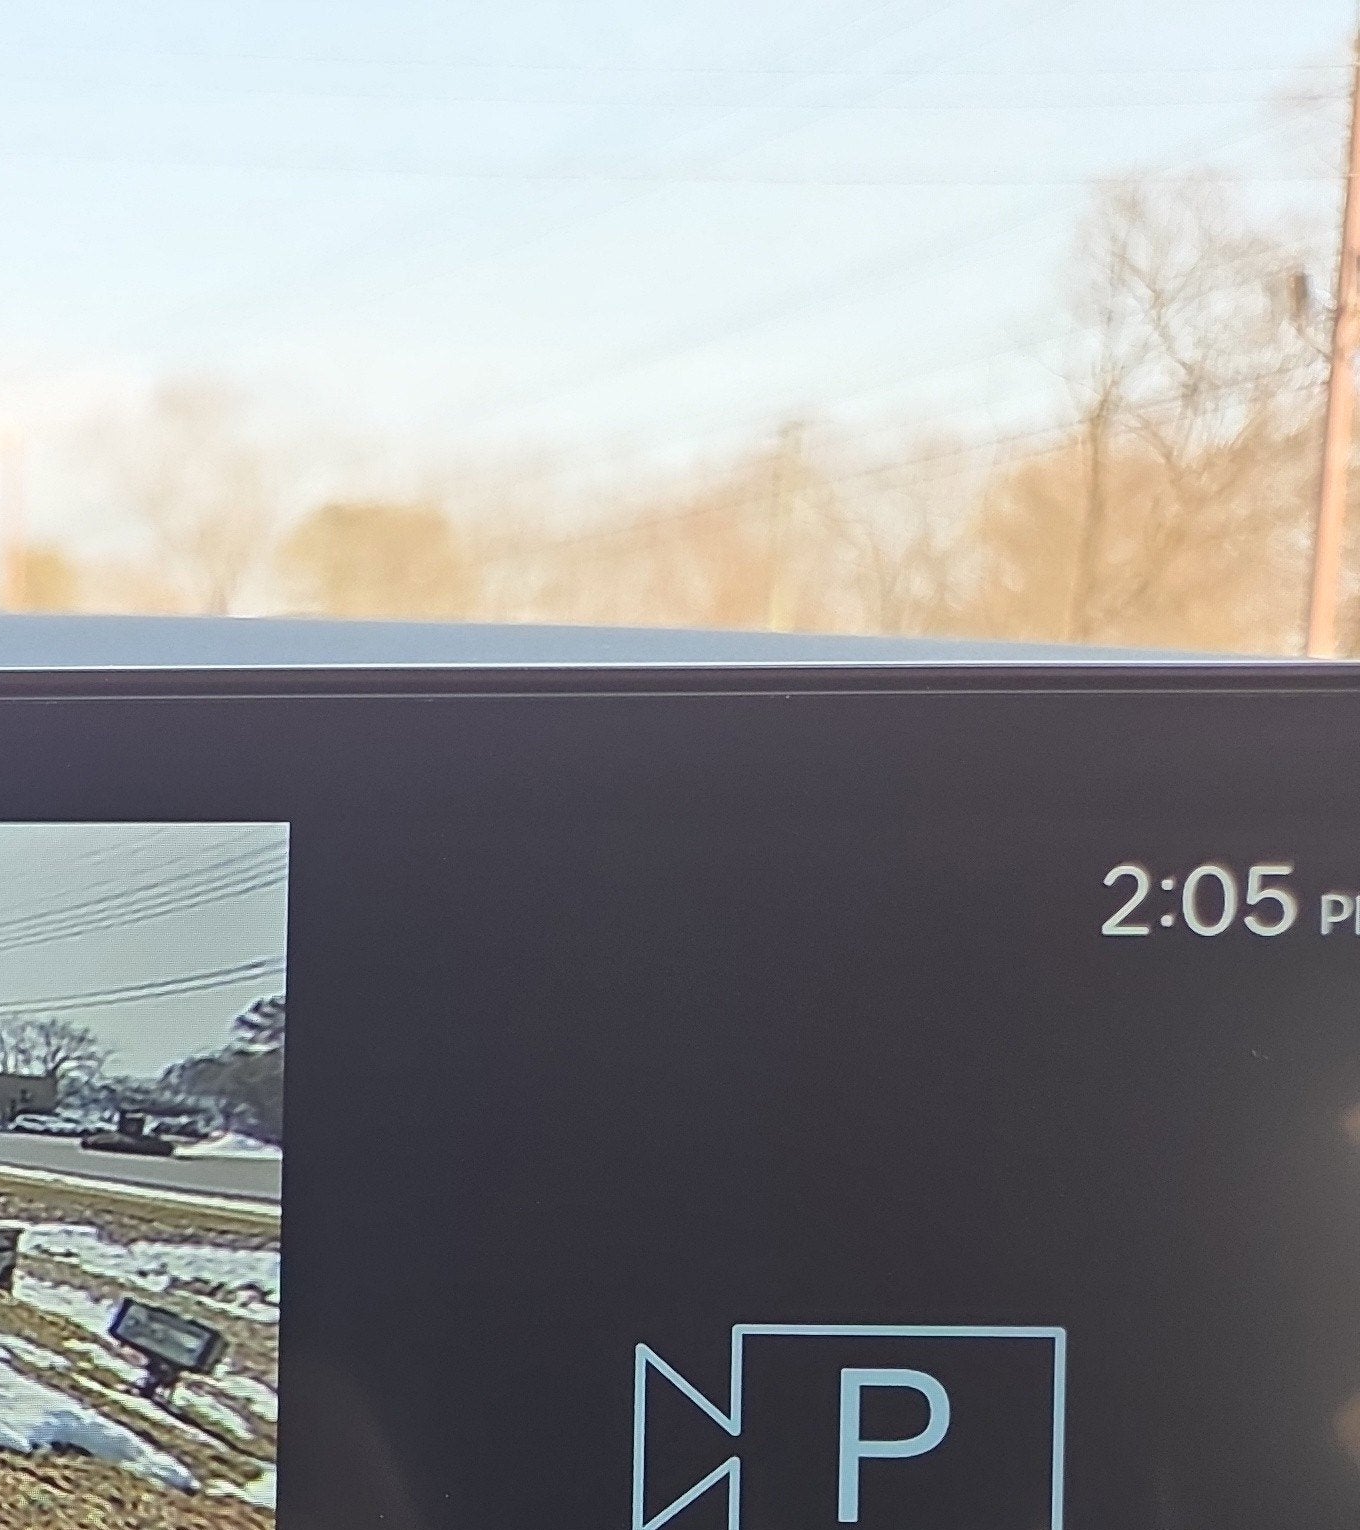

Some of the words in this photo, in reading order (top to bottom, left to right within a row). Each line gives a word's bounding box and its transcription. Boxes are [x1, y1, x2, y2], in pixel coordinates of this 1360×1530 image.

[1100, 864, 1298, 937] 2:05
[1320, 893, 1360, 936] P
[837, 1367, 951, 1523] P
